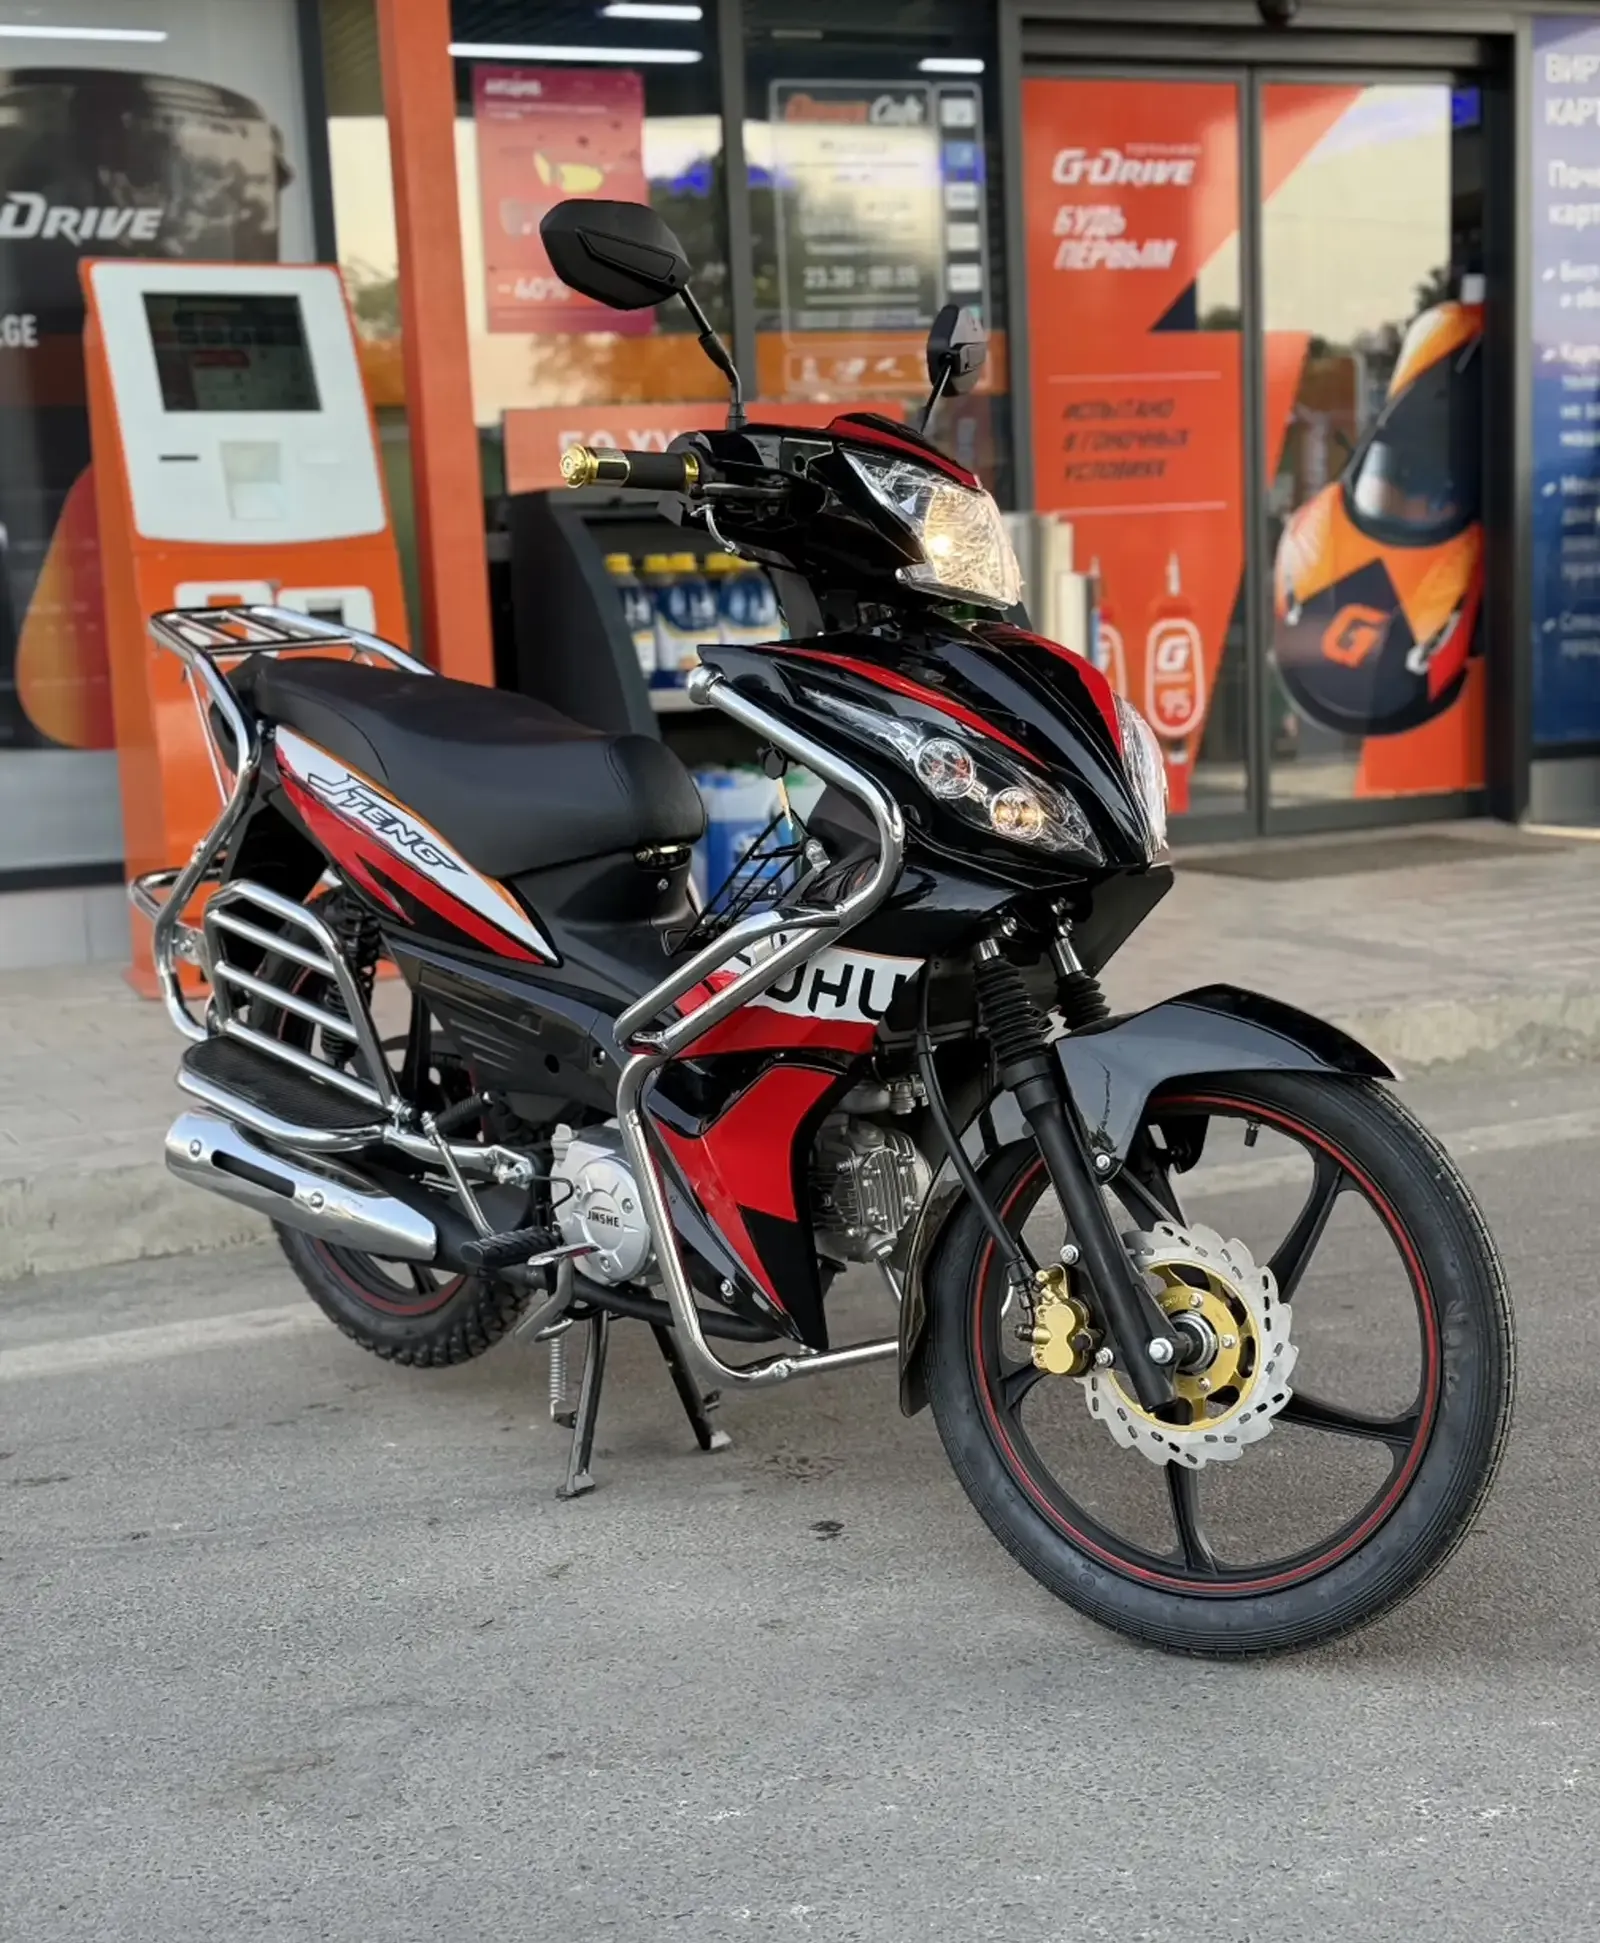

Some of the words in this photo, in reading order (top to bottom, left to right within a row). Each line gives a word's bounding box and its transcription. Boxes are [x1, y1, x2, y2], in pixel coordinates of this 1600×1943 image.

[1053, 238, 1178, 270] ПЕРВЫМ
[0, 314, 38, 348] GE
[587, 1210, 620, 1228] JINSHE
